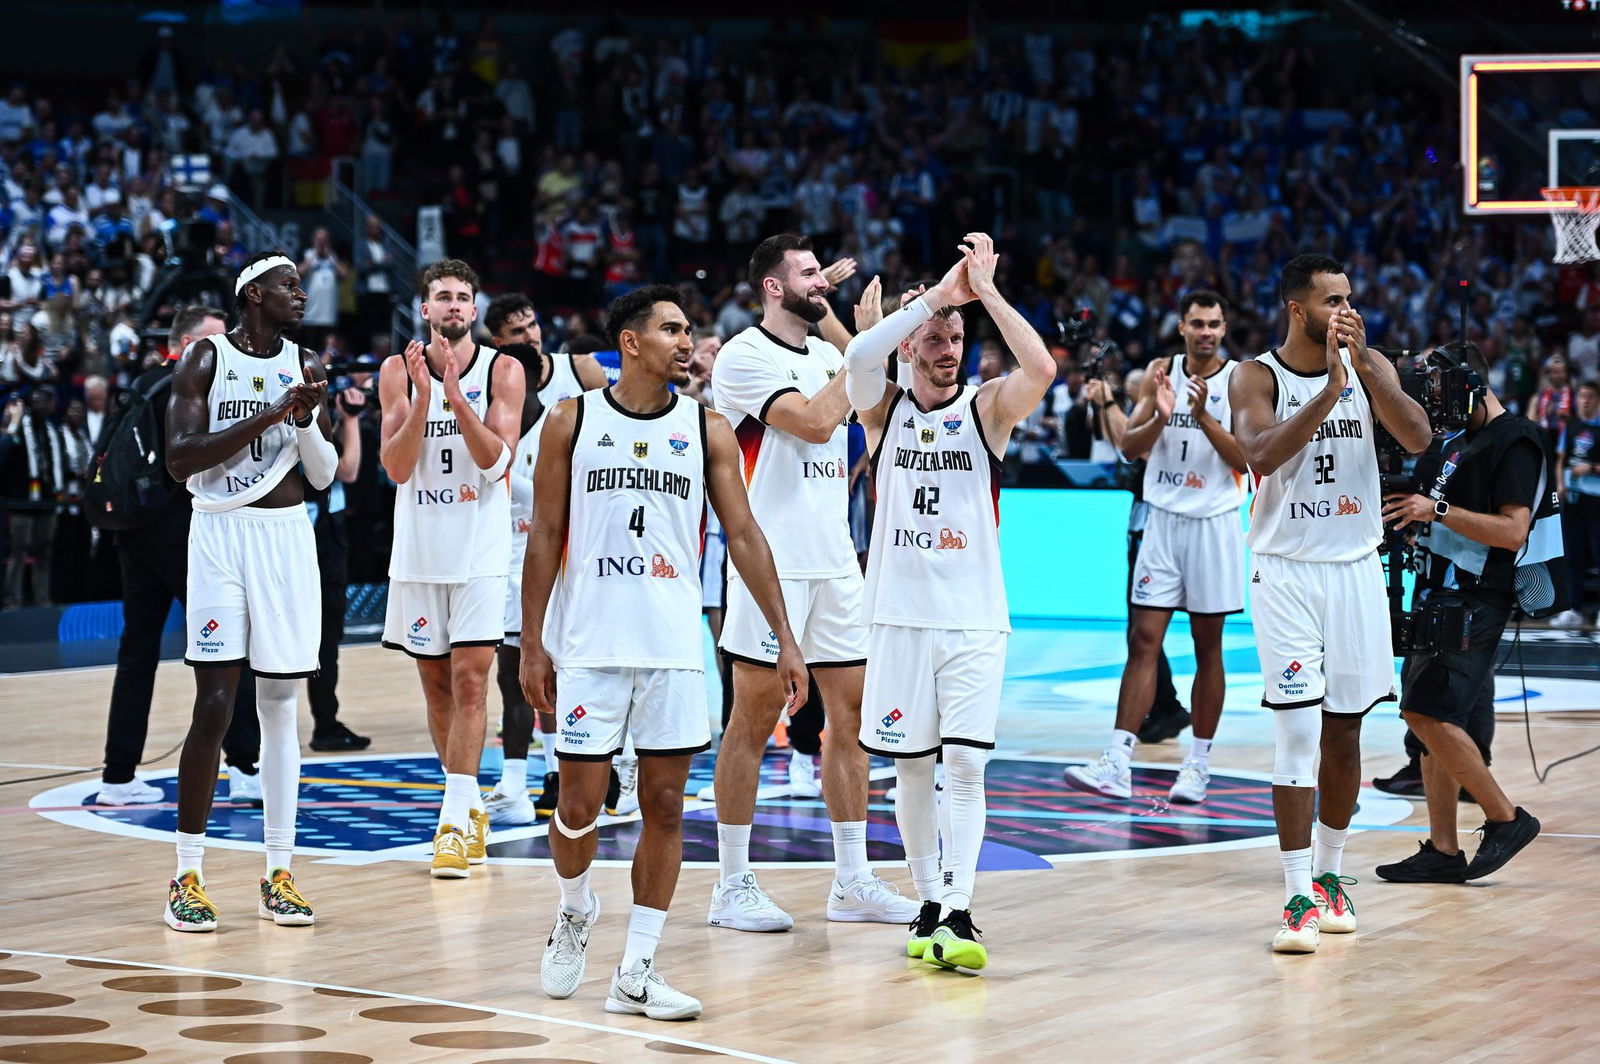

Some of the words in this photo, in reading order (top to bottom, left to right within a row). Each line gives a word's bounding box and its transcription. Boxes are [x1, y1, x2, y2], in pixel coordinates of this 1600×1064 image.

[1181, 440, 1188, 462] 1
[441, 448, 453, 475] 9
[802, 461, 835, 479] ING
[1314, 453, 1336, 486] 32
[586, 467, 691, 501] DEUTSCHLAND
[1158, 469, 1184, 487] ING
[416, 488, 454, 505] ING
[912, 485, 940, 516] 42
[1289, 500, 1331, 520] ING
[628, 505, 645, 539] 4
[893, 528, 933, 550] ING
[596, 556, 646, 578] ING
[761, 640, 781, 650] Domin
[1278, 681, 1308, 689] Domino's
[560, 728, 591, 739] Domino's
[564, 736, 583, 745] Pizza
[875, 728, 906, 739] Domino's
[880, 736, 899, 744] Pizza
